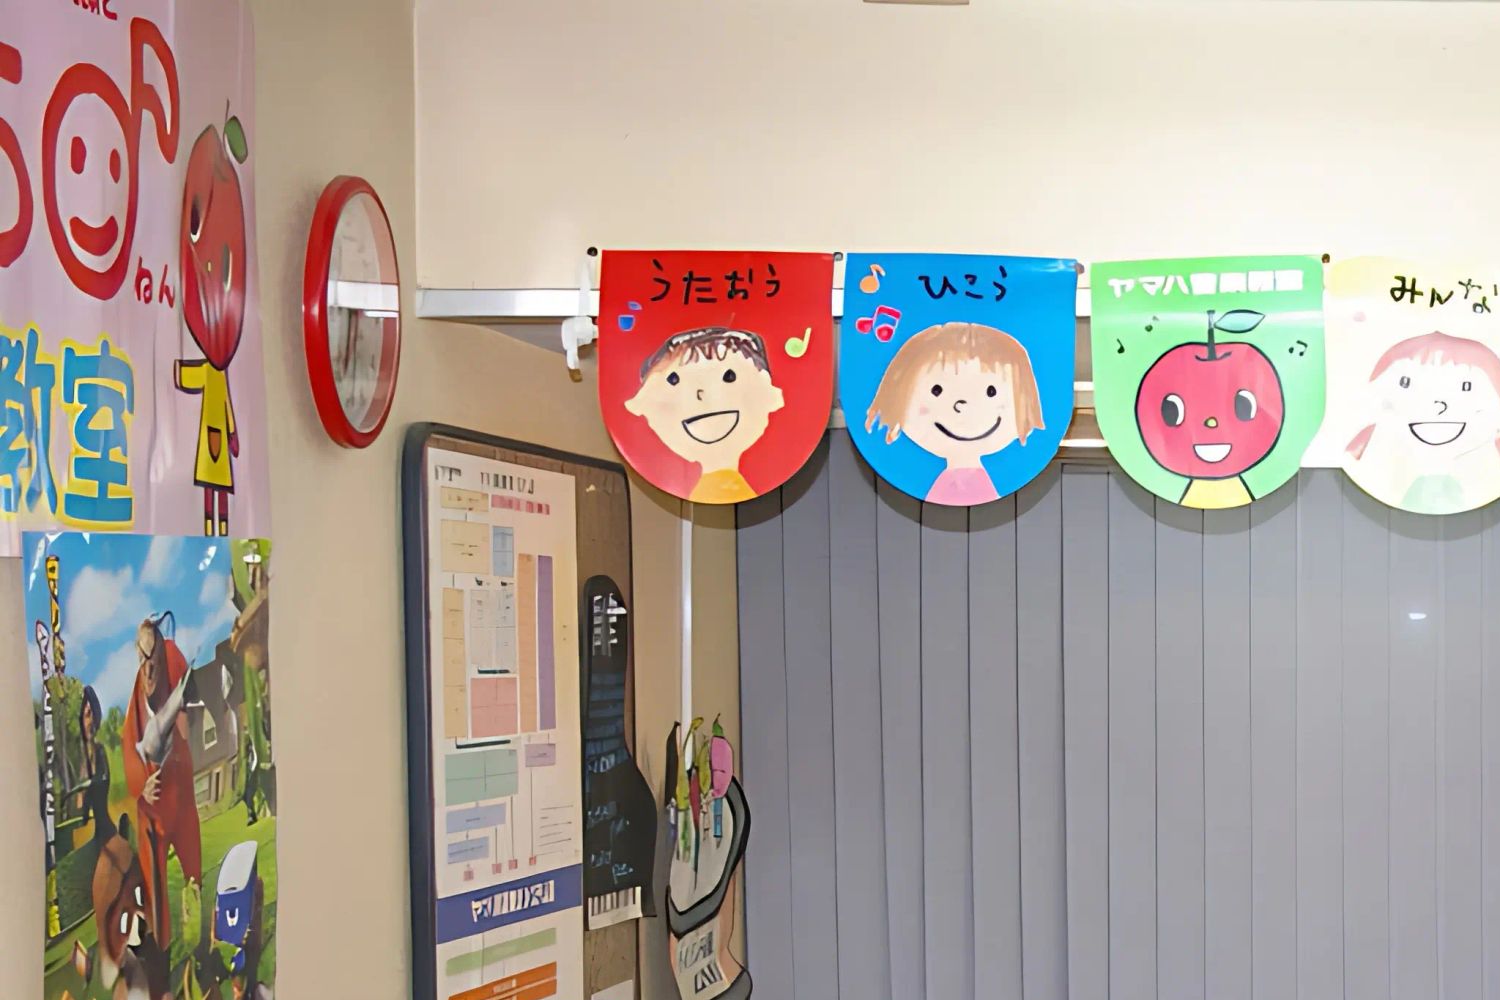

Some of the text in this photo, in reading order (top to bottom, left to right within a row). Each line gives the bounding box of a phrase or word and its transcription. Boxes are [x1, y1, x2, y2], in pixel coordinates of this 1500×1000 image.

[650, 259, 781, 304] うたおう
[918, 265, 1008, 300] ひこう
[1390, 275, 1499, 313] みんな
